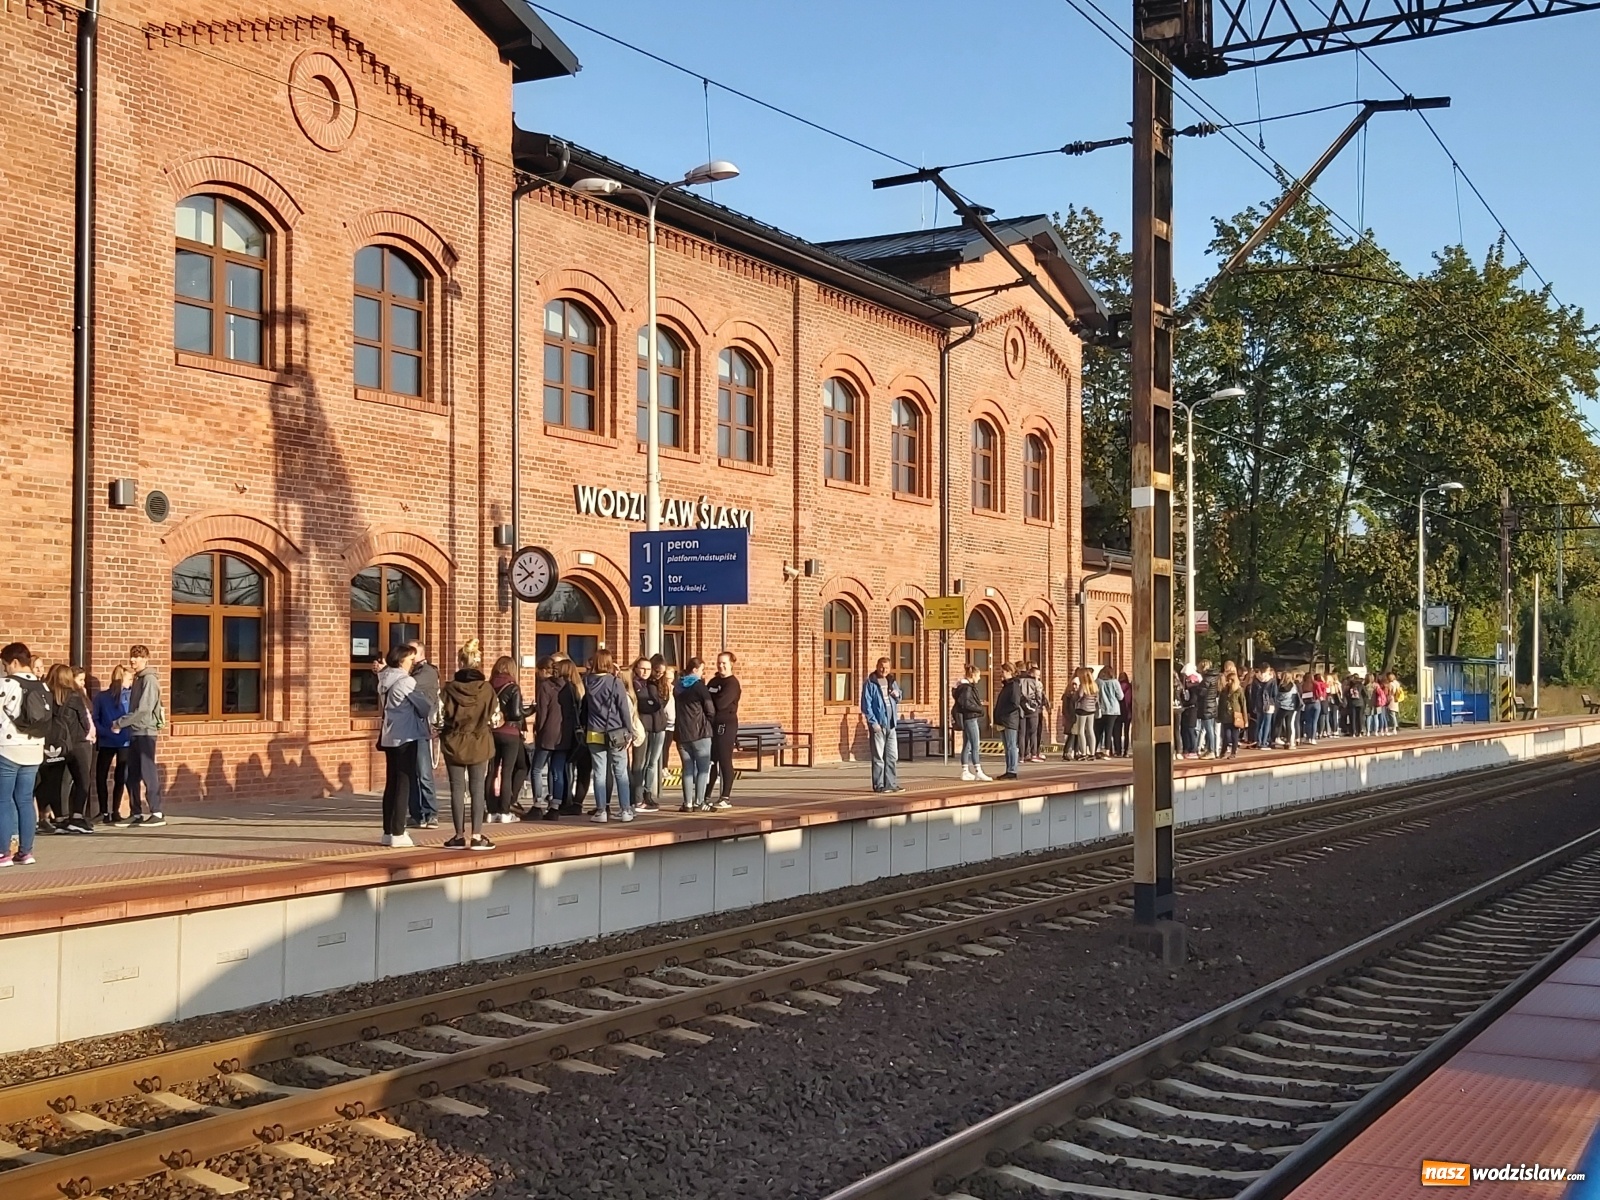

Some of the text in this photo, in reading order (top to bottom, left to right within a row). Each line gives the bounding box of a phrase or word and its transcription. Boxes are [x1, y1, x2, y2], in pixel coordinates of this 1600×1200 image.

[667, 540, 699, 552] peron
[642, 542, 651, 563] 1
[642, 575, 653, 593] 3
[668, 574, 683, 584] tor
[668, 585, 701, 593] track/kolej
